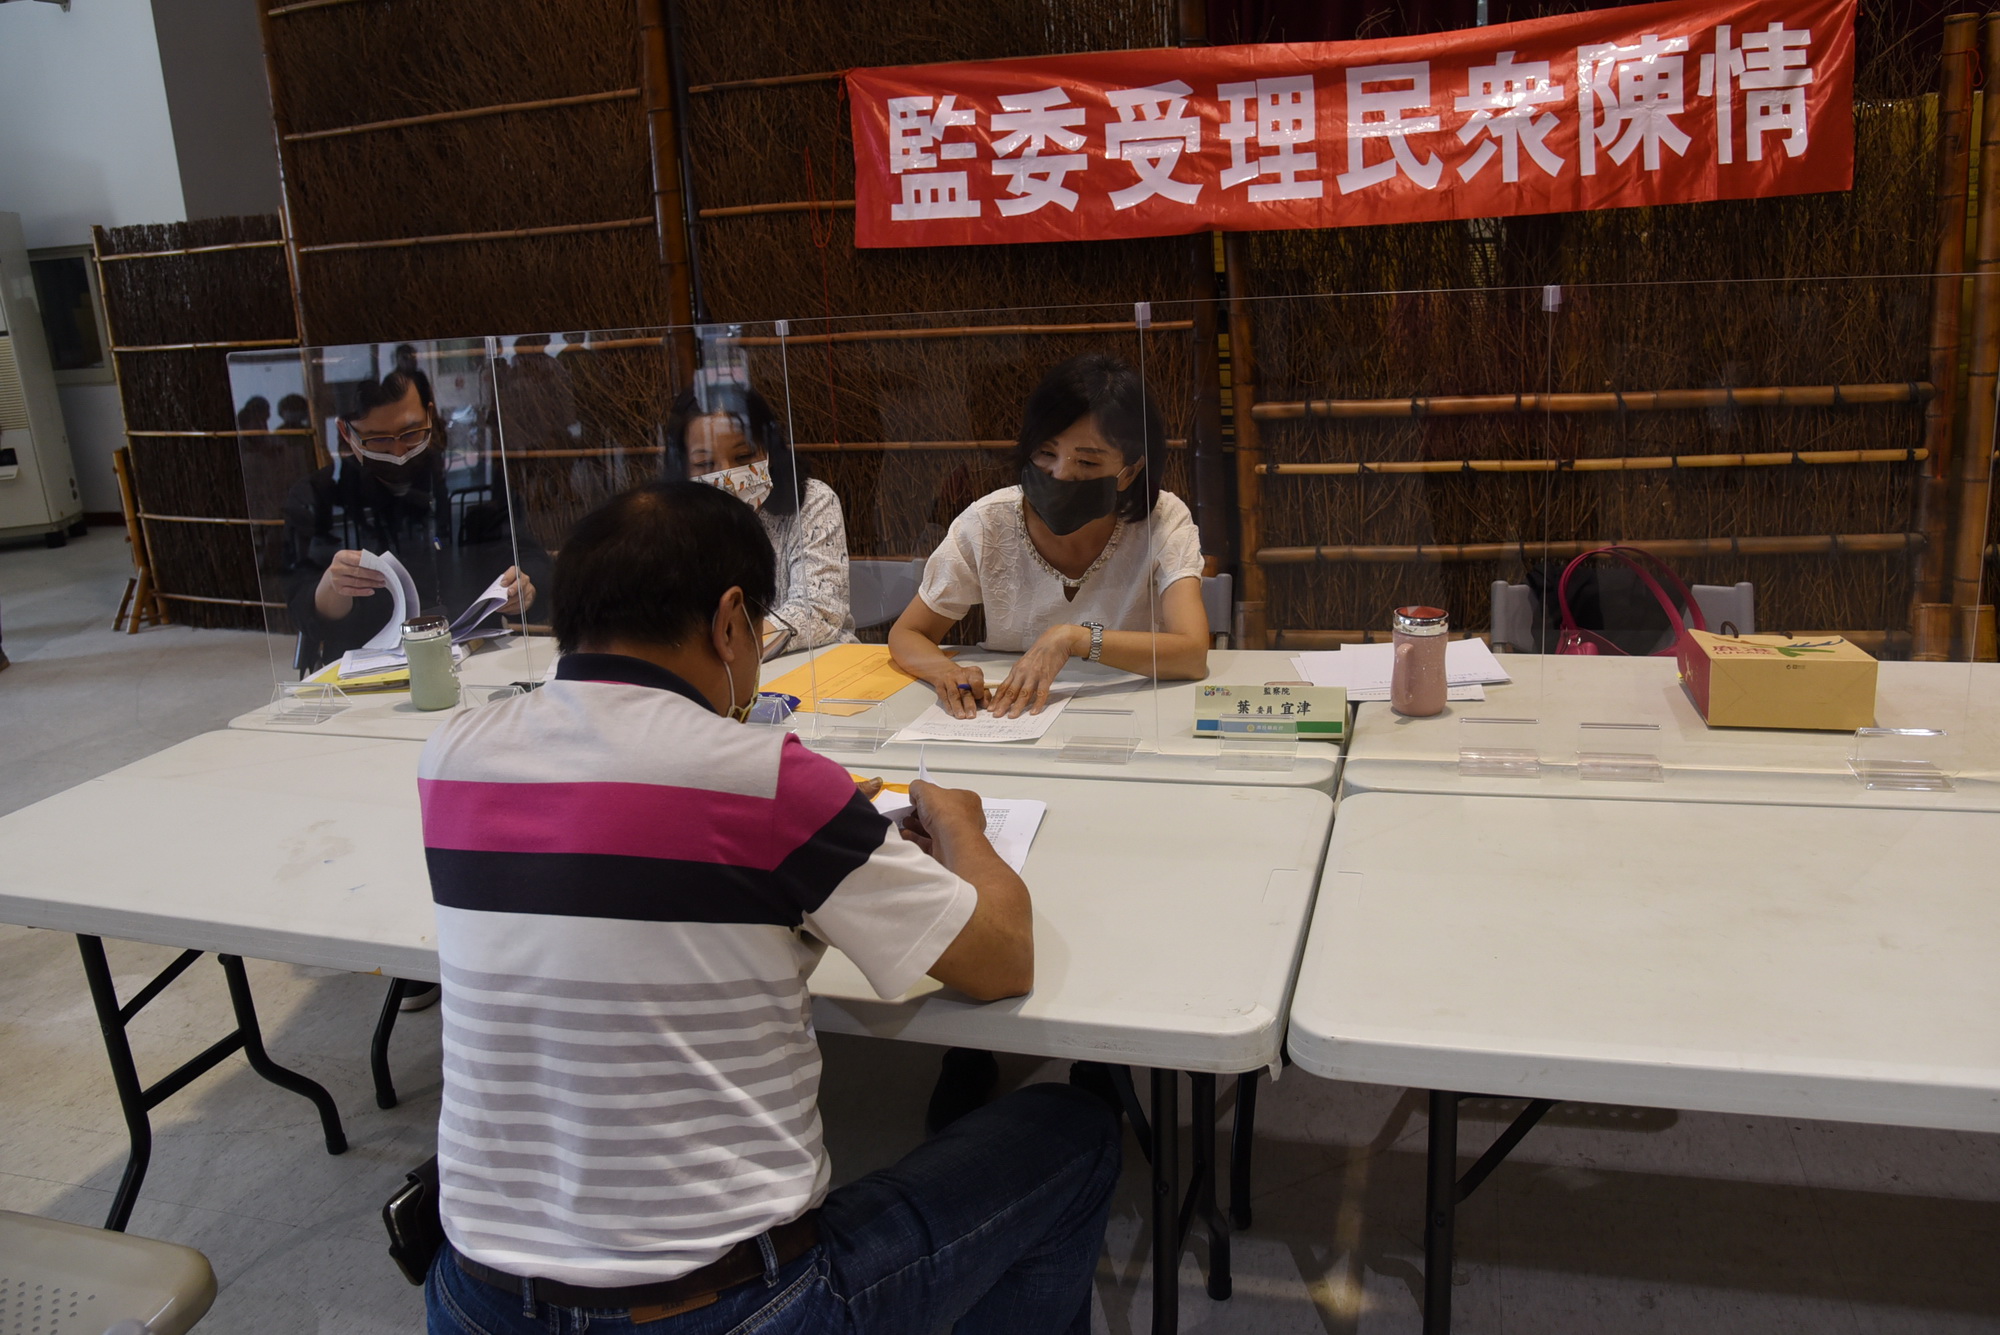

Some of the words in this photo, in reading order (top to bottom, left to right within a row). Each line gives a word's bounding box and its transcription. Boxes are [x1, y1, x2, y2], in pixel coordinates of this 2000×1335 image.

[1263, 687, 1291, 696] 監察院
[1237, 700, 1251, 714] 葉
[1256, 705, 1273, 715] 委員
